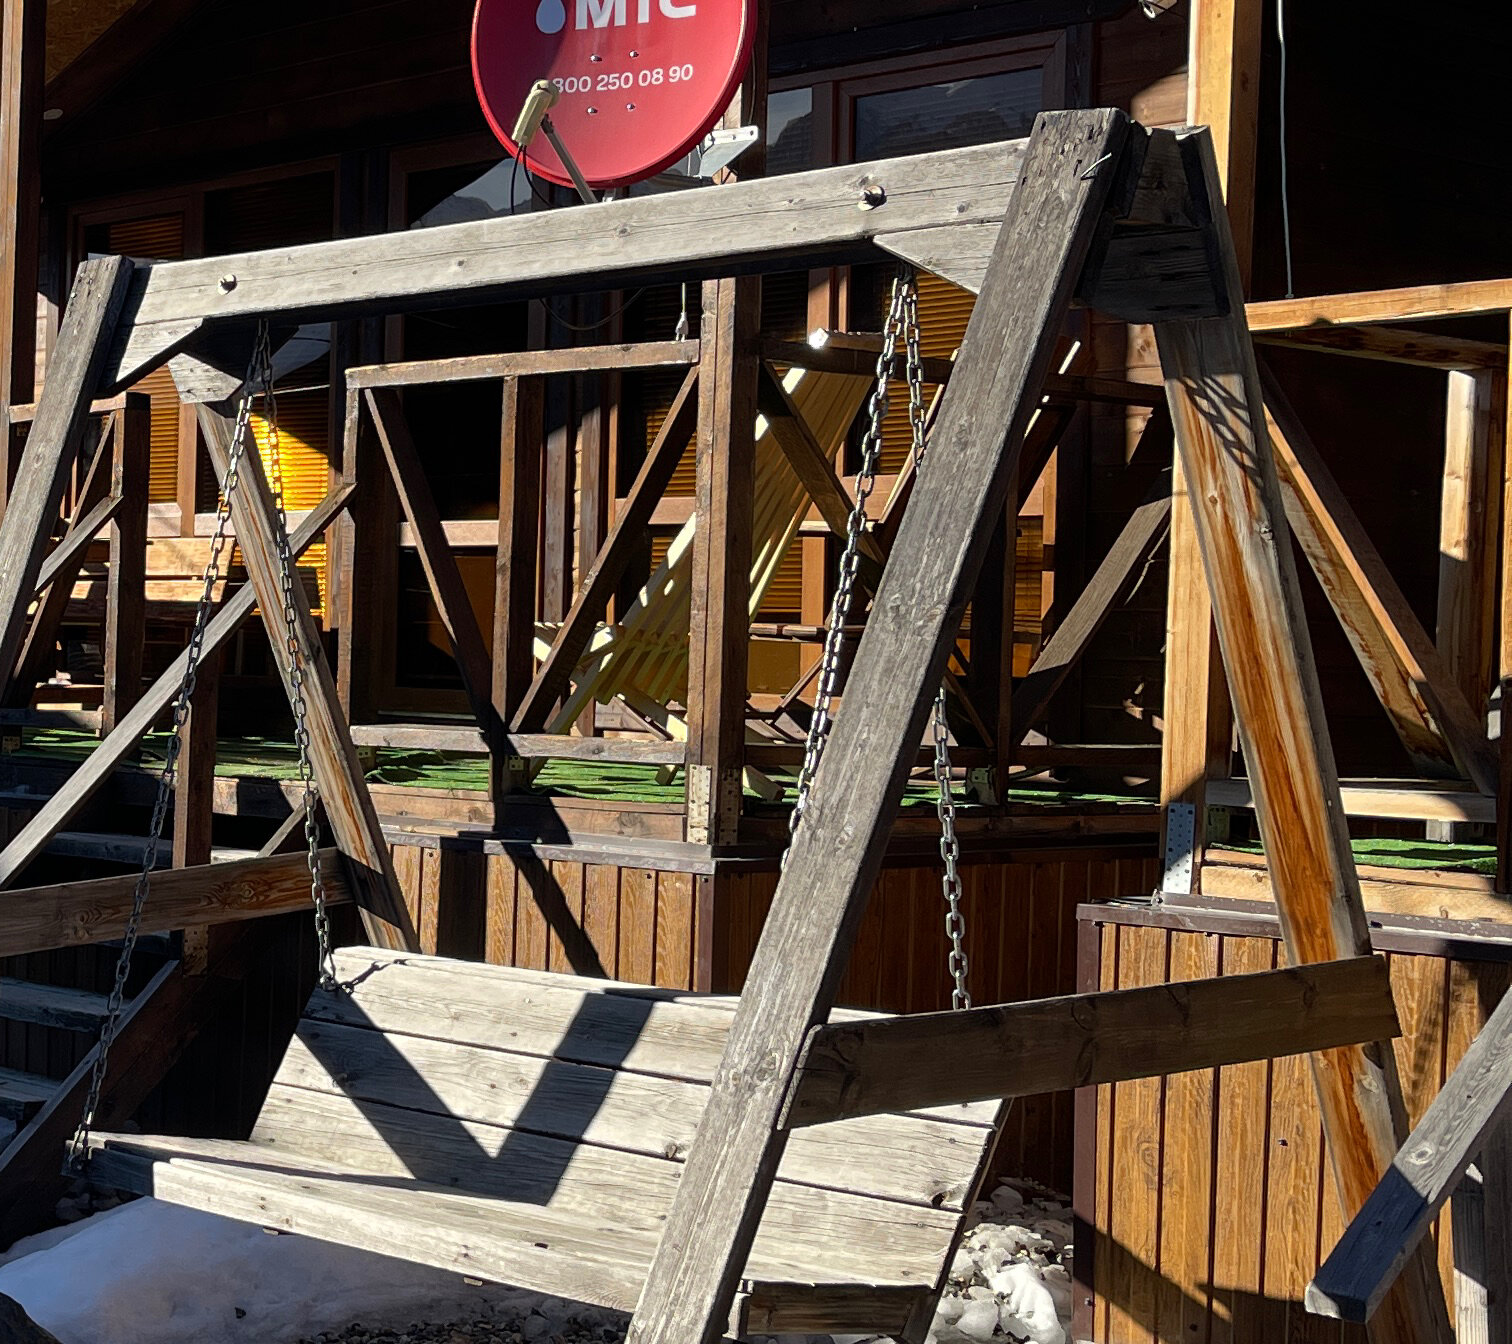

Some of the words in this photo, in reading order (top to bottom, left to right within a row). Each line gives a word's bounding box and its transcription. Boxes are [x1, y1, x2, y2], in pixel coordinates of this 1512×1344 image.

[552, 75, 592, 93] 800
[596, 71, 633, 91] 250
[638, 67, 664, 86] 08
[669, 63, 693, 83] 90
